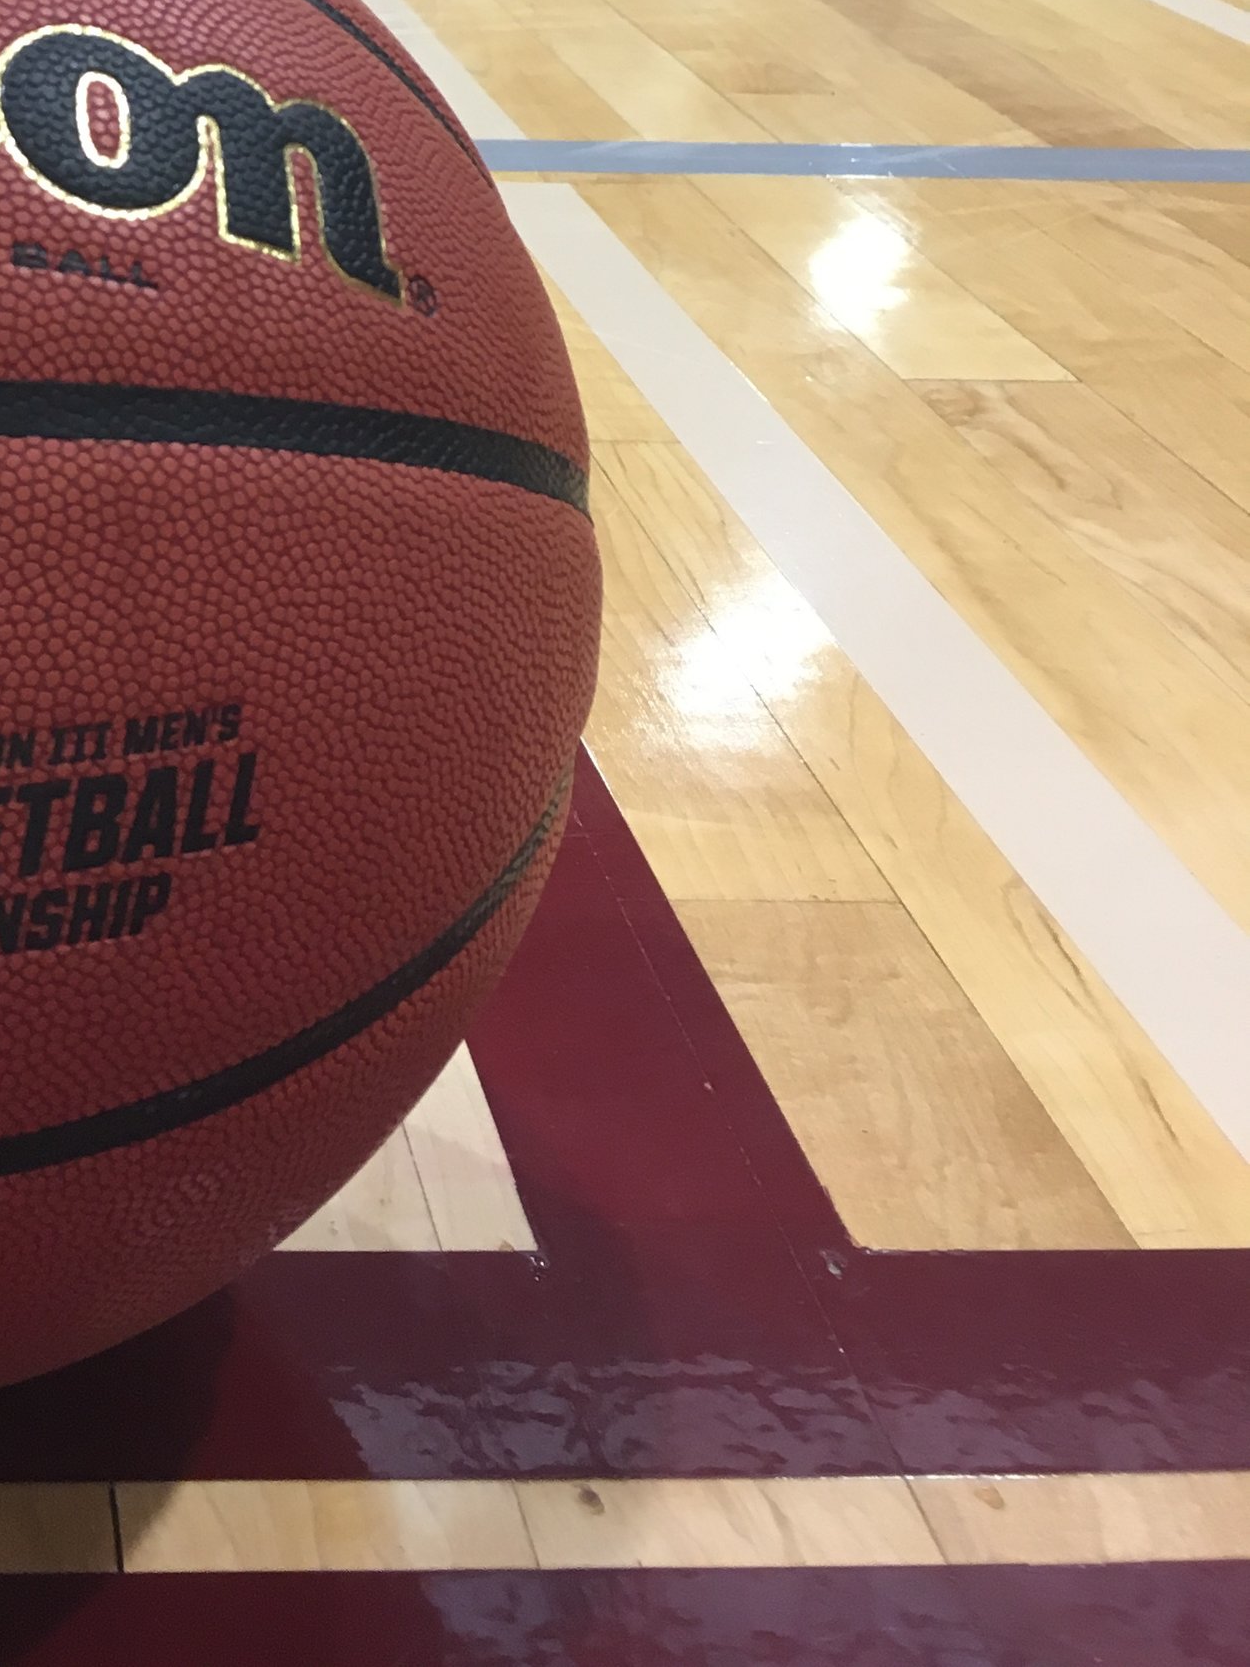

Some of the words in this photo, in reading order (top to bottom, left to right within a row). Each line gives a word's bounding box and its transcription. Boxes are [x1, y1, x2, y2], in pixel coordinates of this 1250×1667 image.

[12, 240, 159, 290] BALL
[46, 723, 114, 766] III
[123, 704, 242, 757] MEN'S
